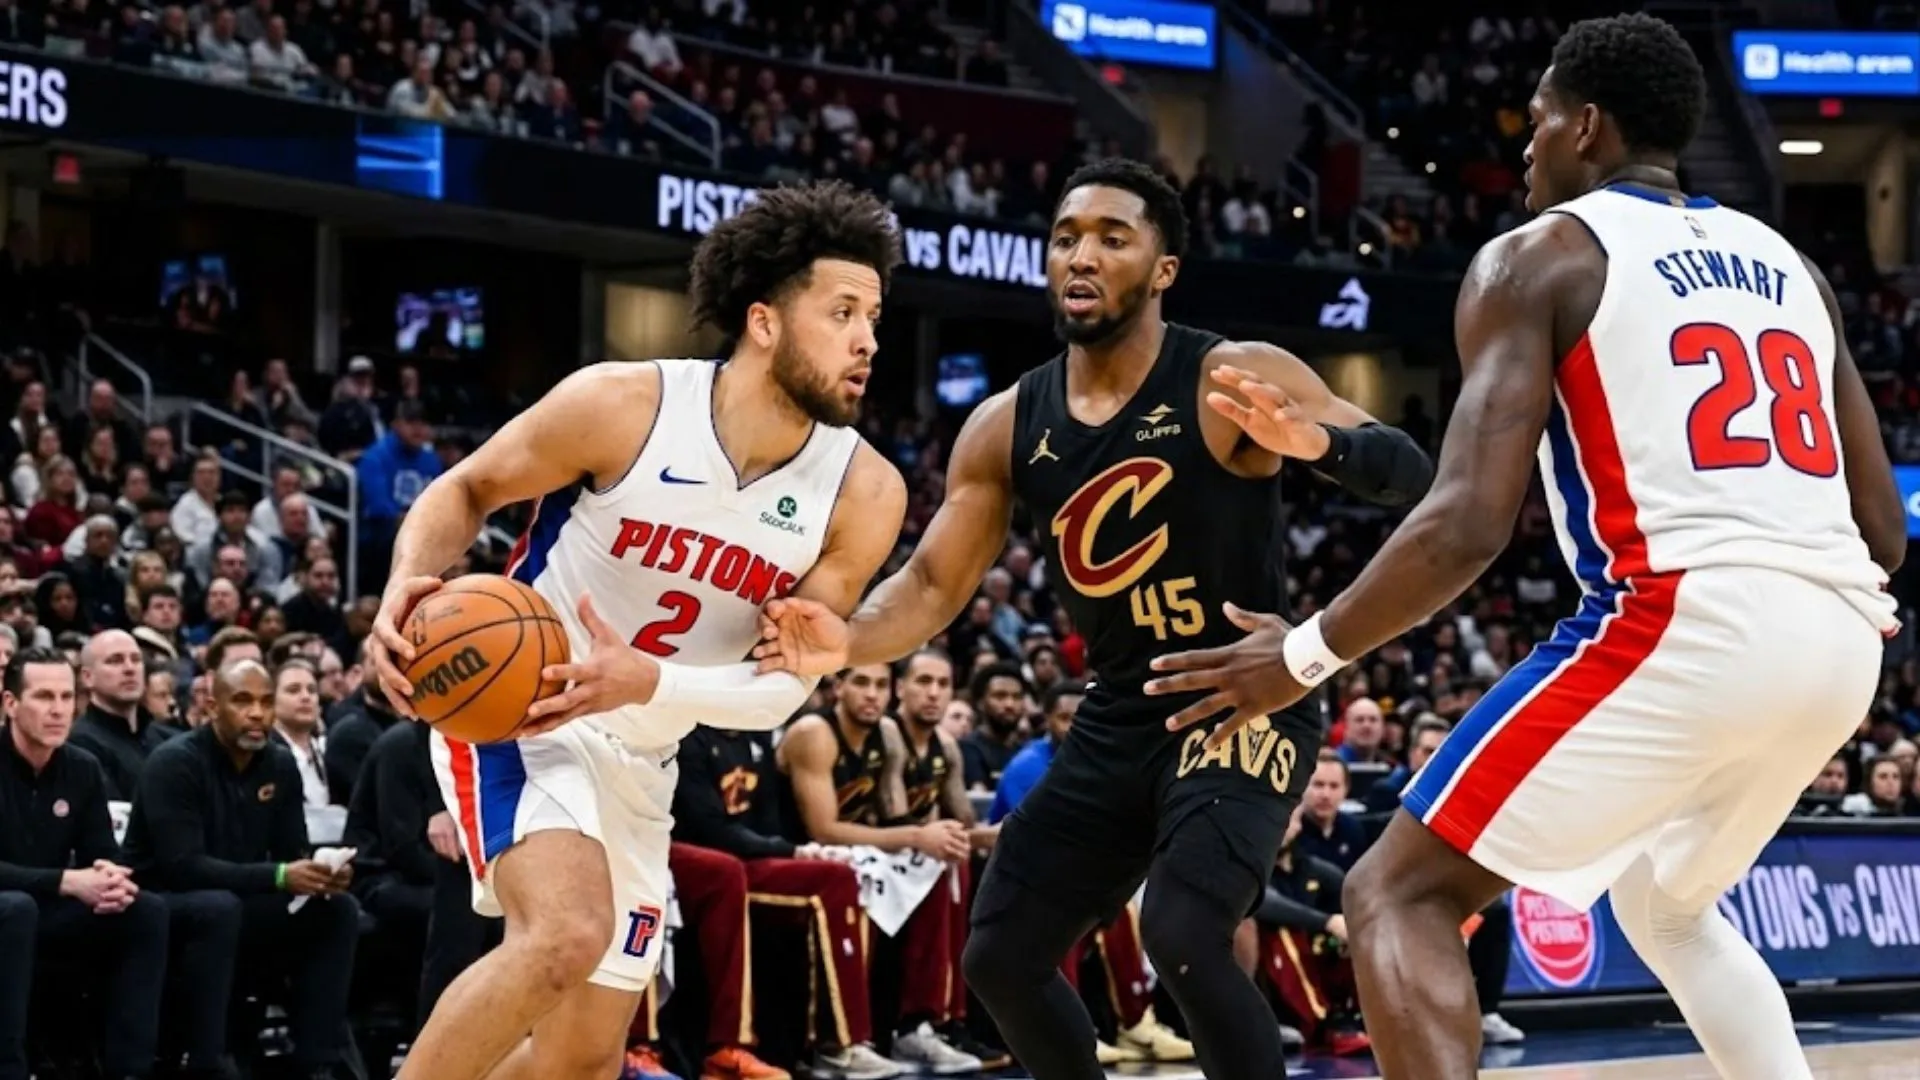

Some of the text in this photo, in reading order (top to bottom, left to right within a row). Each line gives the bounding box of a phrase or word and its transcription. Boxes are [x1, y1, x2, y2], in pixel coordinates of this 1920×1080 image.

[948, 223, 1049, 288] CAVAL
[1654, 249, 1788, 306] STEWART
[1669, 321, 1839, 479] 28
[610, 517, 797, 607] PISTONS
[1051, 456, 1174, 598] C
[630, 590, 702, 658] 2
[1130, 576, 1206, 641] 45
[1176, 717, 1297, 794] CAVS
